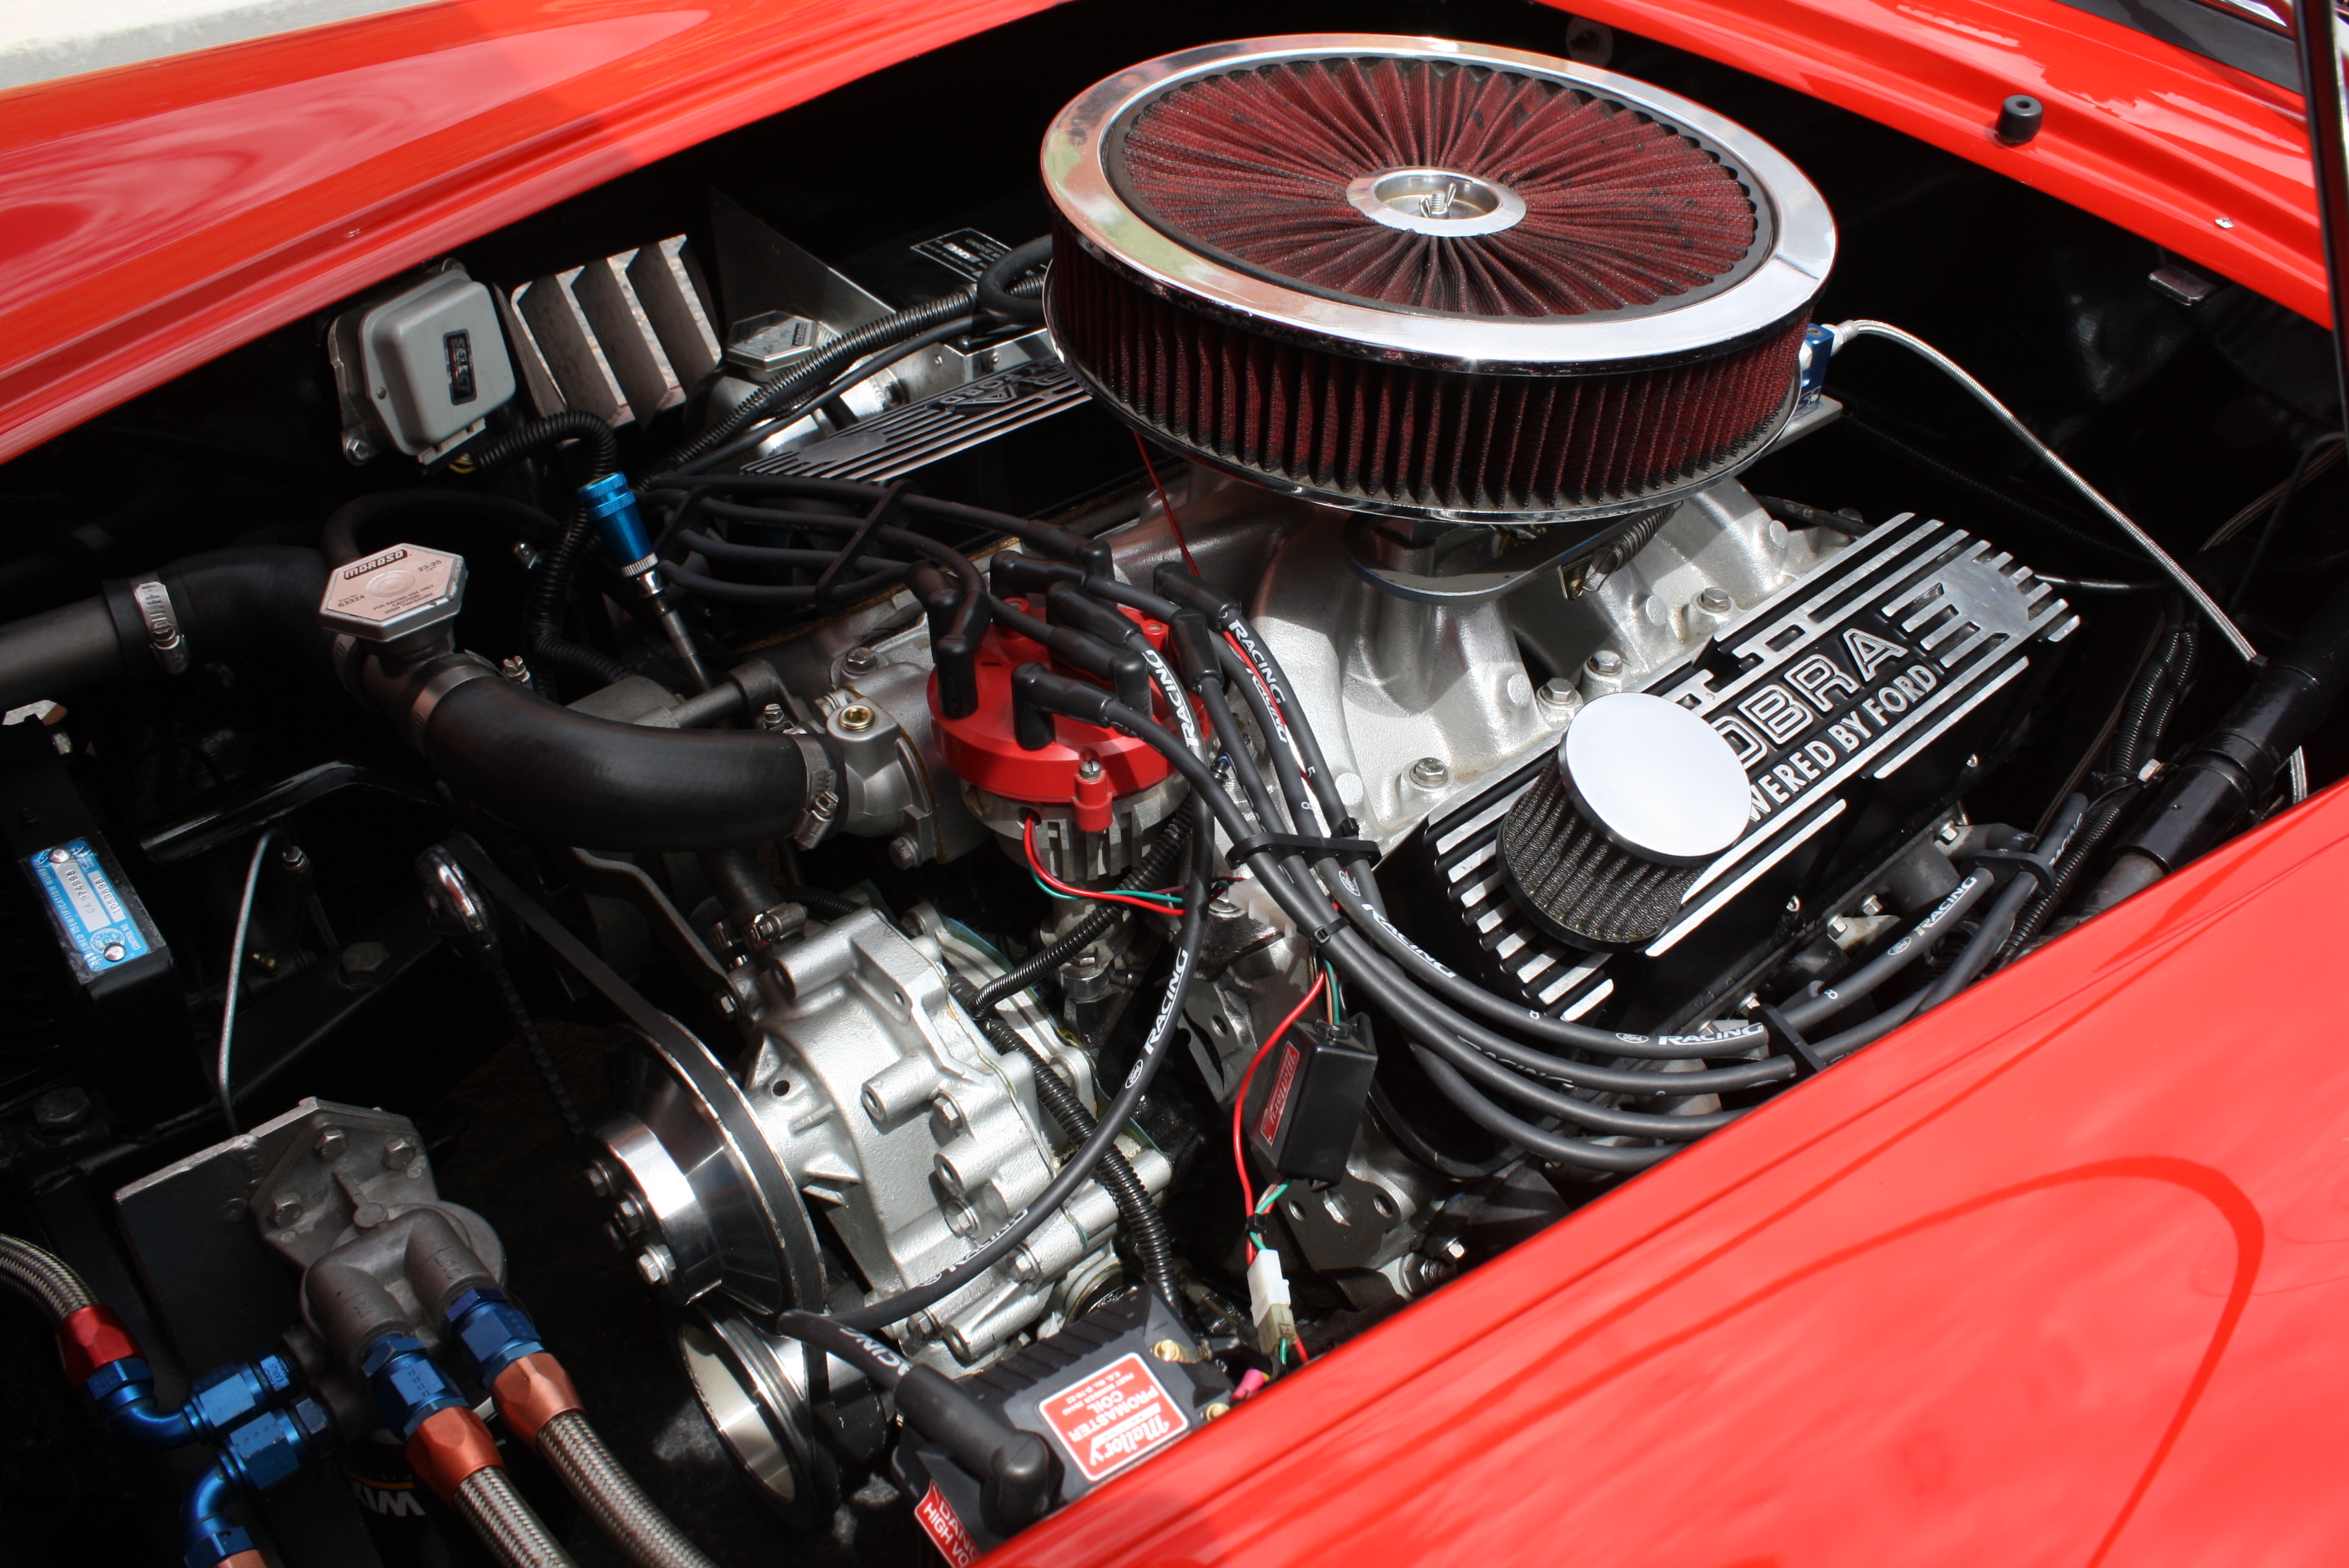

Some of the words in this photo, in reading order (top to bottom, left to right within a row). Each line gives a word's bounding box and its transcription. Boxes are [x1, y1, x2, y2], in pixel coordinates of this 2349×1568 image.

[344, 549, 408, 580] MOROSO
[1228, 619, 1286, 704] RACING
[1142, 649, 1200, 748] RACING
[1710, 627, 1909, 770] OBRA
[1749, 740, 1837, 822] WERED
[1827, 711, 1872, 752] BY
[1862, 665, 1937, 727] FORD
[49, 886, 80, 933] IDENTIFICATION
[1914, 877, 1977, 937] RACING
[125, 932, 141, 950] CONTROL
[1144, 947, 1189, 1055] RACING
[1657, 1022, 1764, 1046] RACING
[1270, 1053, 1296, 1125] Mallory
[1084, 1384, 1115, 1404] NUMBER
[1086, 1390, 1124, 1414] COIL
[1115, 1372, 1134, 1387] PART
[1068, 1385, 1159, 1442] PROMASTER
[1089, 1415, 1169, 1466] Mallory
[923, 1502, 953, 1545] HIGH
